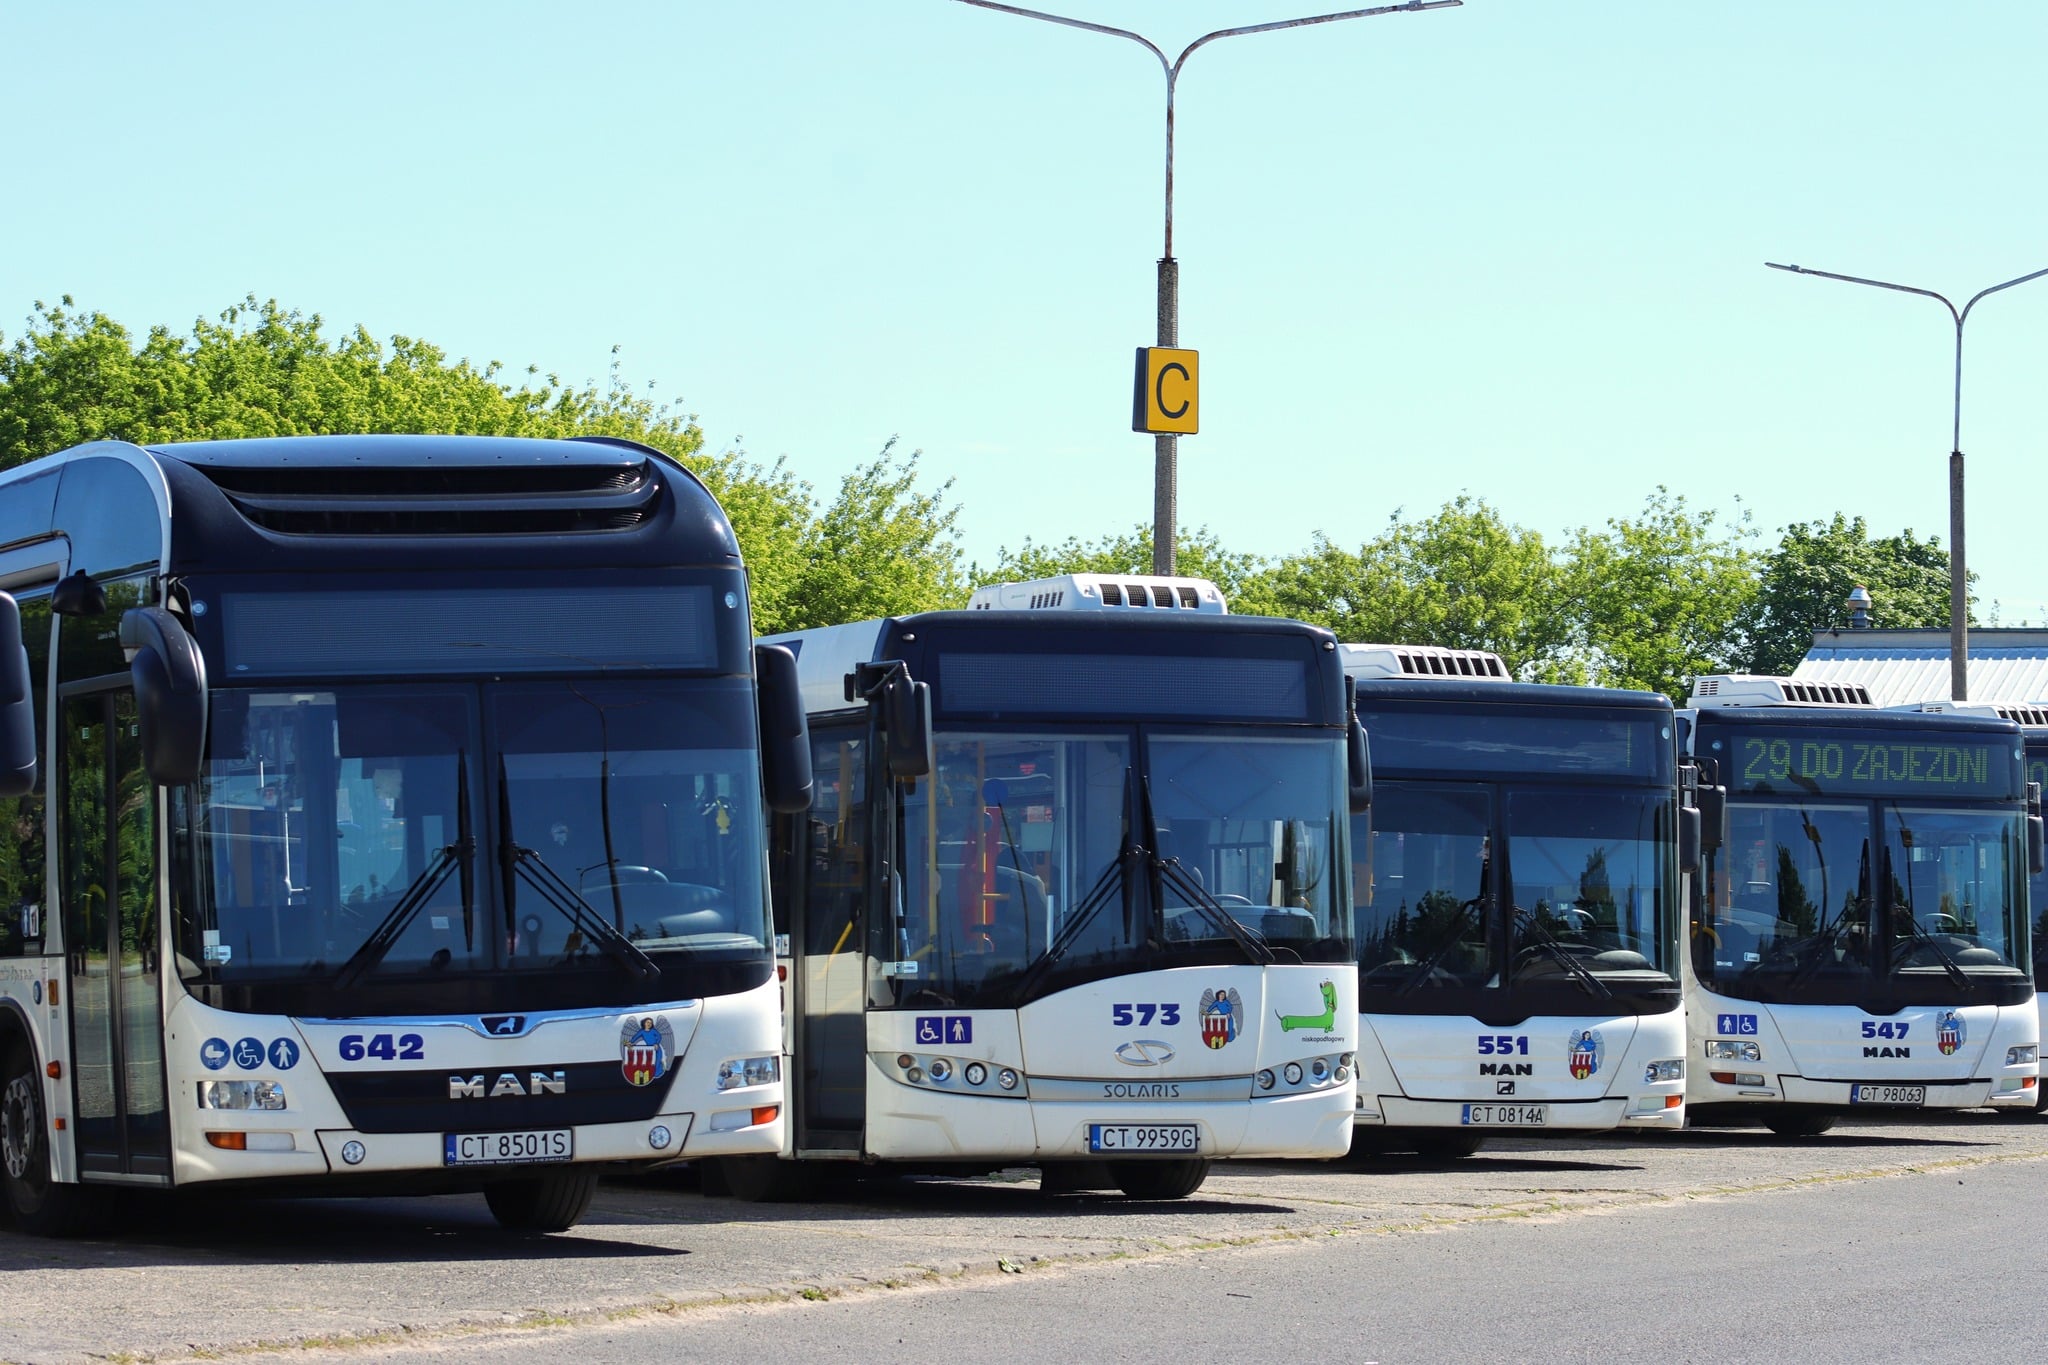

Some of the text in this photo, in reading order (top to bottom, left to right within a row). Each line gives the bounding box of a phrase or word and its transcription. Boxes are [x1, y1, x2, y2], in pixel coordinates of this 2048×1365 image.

[1156, 362, 1190, 419] C
[1744, 738, 1988, 784] 29 DO ZAJEZDNI
[1112, 1003, 1181, 1027] 573
[1861, 1021, 1910, 1040] 547
[338, 1033, 425, 1061] 642
[1478, 1035, 1529, 1055] 551
[1863, 1046, 1911, 1059] MAN
[1480, 1063, 1533, 1076] MAN
[449, 1070, 567, 1100] MAN
[1104, 1084, 1180, 1098] SOLARIS
[1860, 1086, 1922, 1102] CT 98063
[1472, 1107, 1493, 1123] CT
[1498, 1107, 1544, 1123] 0814A
[461, 1136, 489, 1159] CT
[499, 1132, 566, 1157] 8501S
[1103, 1128, 1129, 1148] CT
[1136, 1128, 1193, 1148] 9959G
